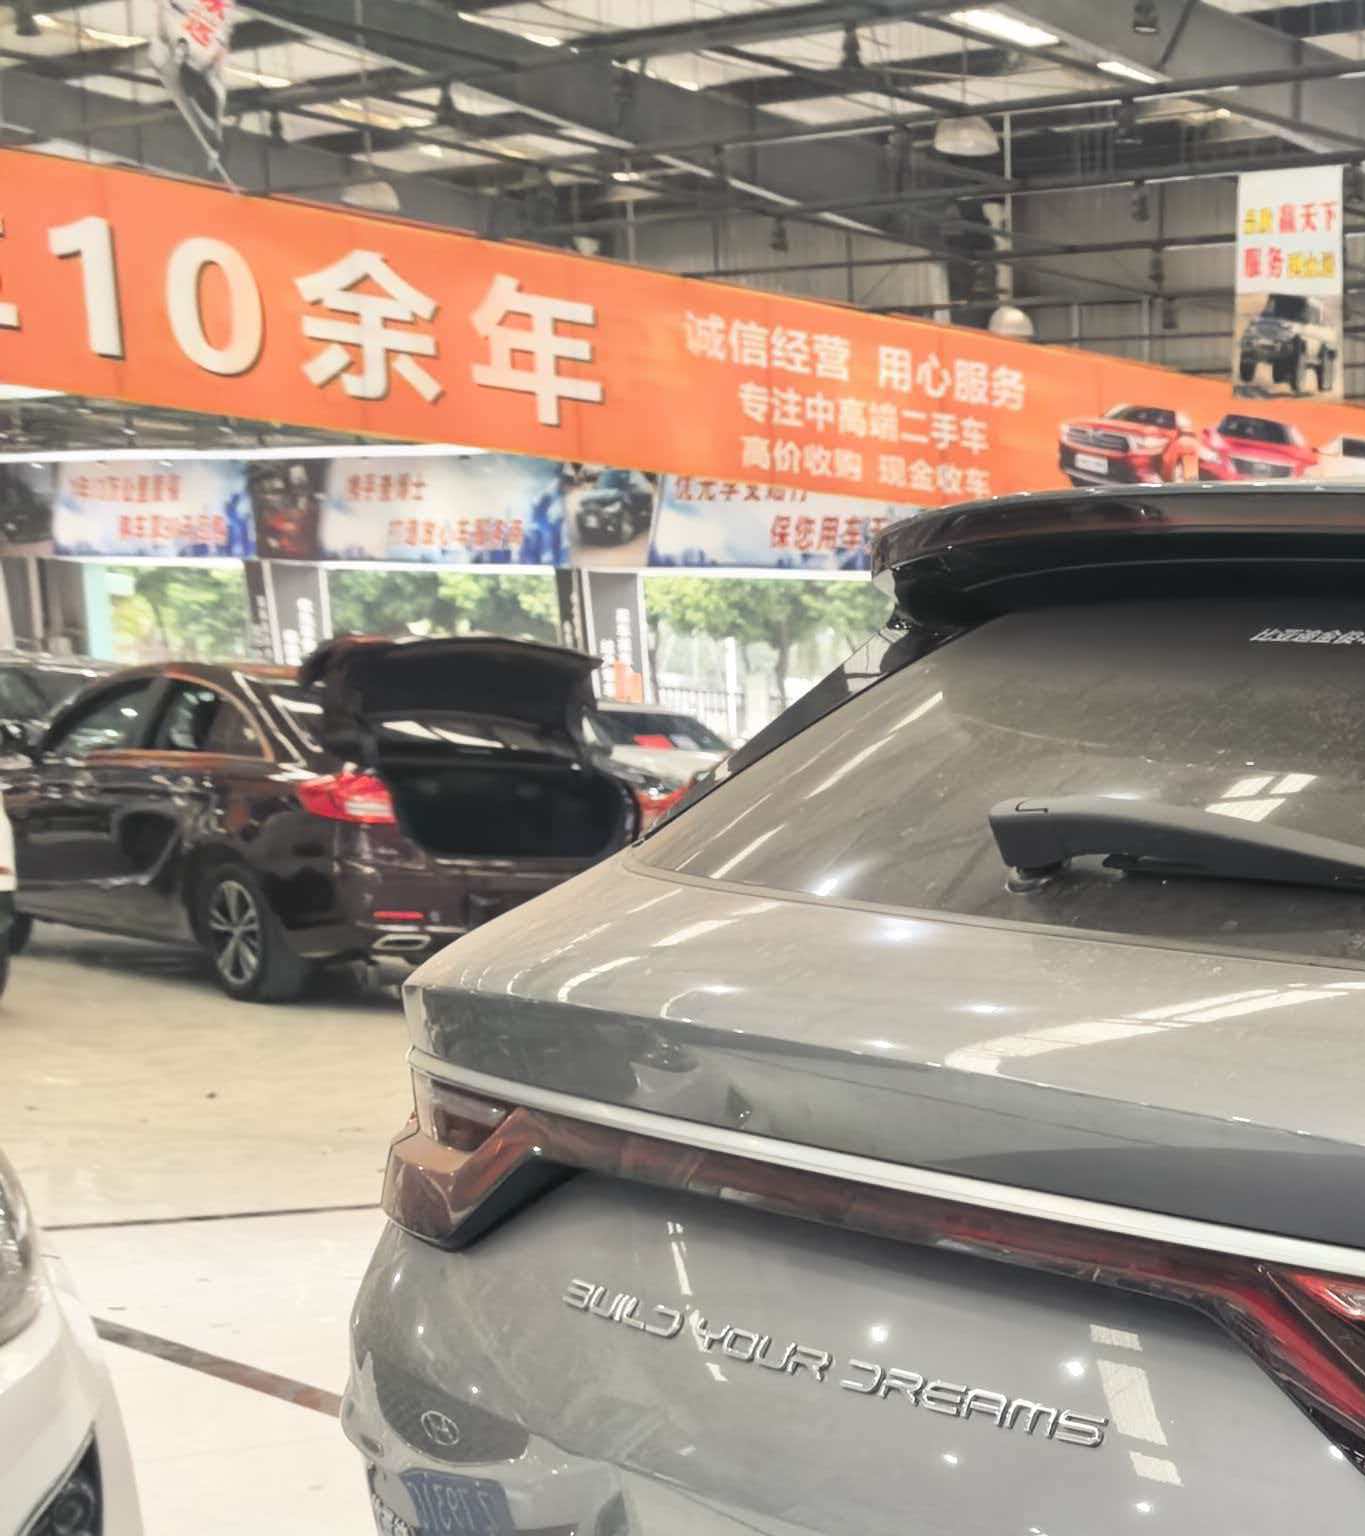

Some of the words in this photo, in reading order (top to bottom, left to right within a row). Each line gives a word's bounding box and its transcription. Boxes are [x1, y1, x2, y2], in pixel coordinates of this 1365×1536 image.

[0, 216, 604, 427] 10余年
[683, 311, 850, 382] 诚信经营
[877, 345, 1026, 411] 用心服务
[739, 381, 991, 457] 专注中高端二手车
[740, 434, 864, 482] 高价收购
[878, 453, 993, 499] 现金收车
[563, 1278, 685, 1339] BUILD
[695, 1316, 833, 1381] YOUR
[839, 1358, 1109, 1448] DREAMS
